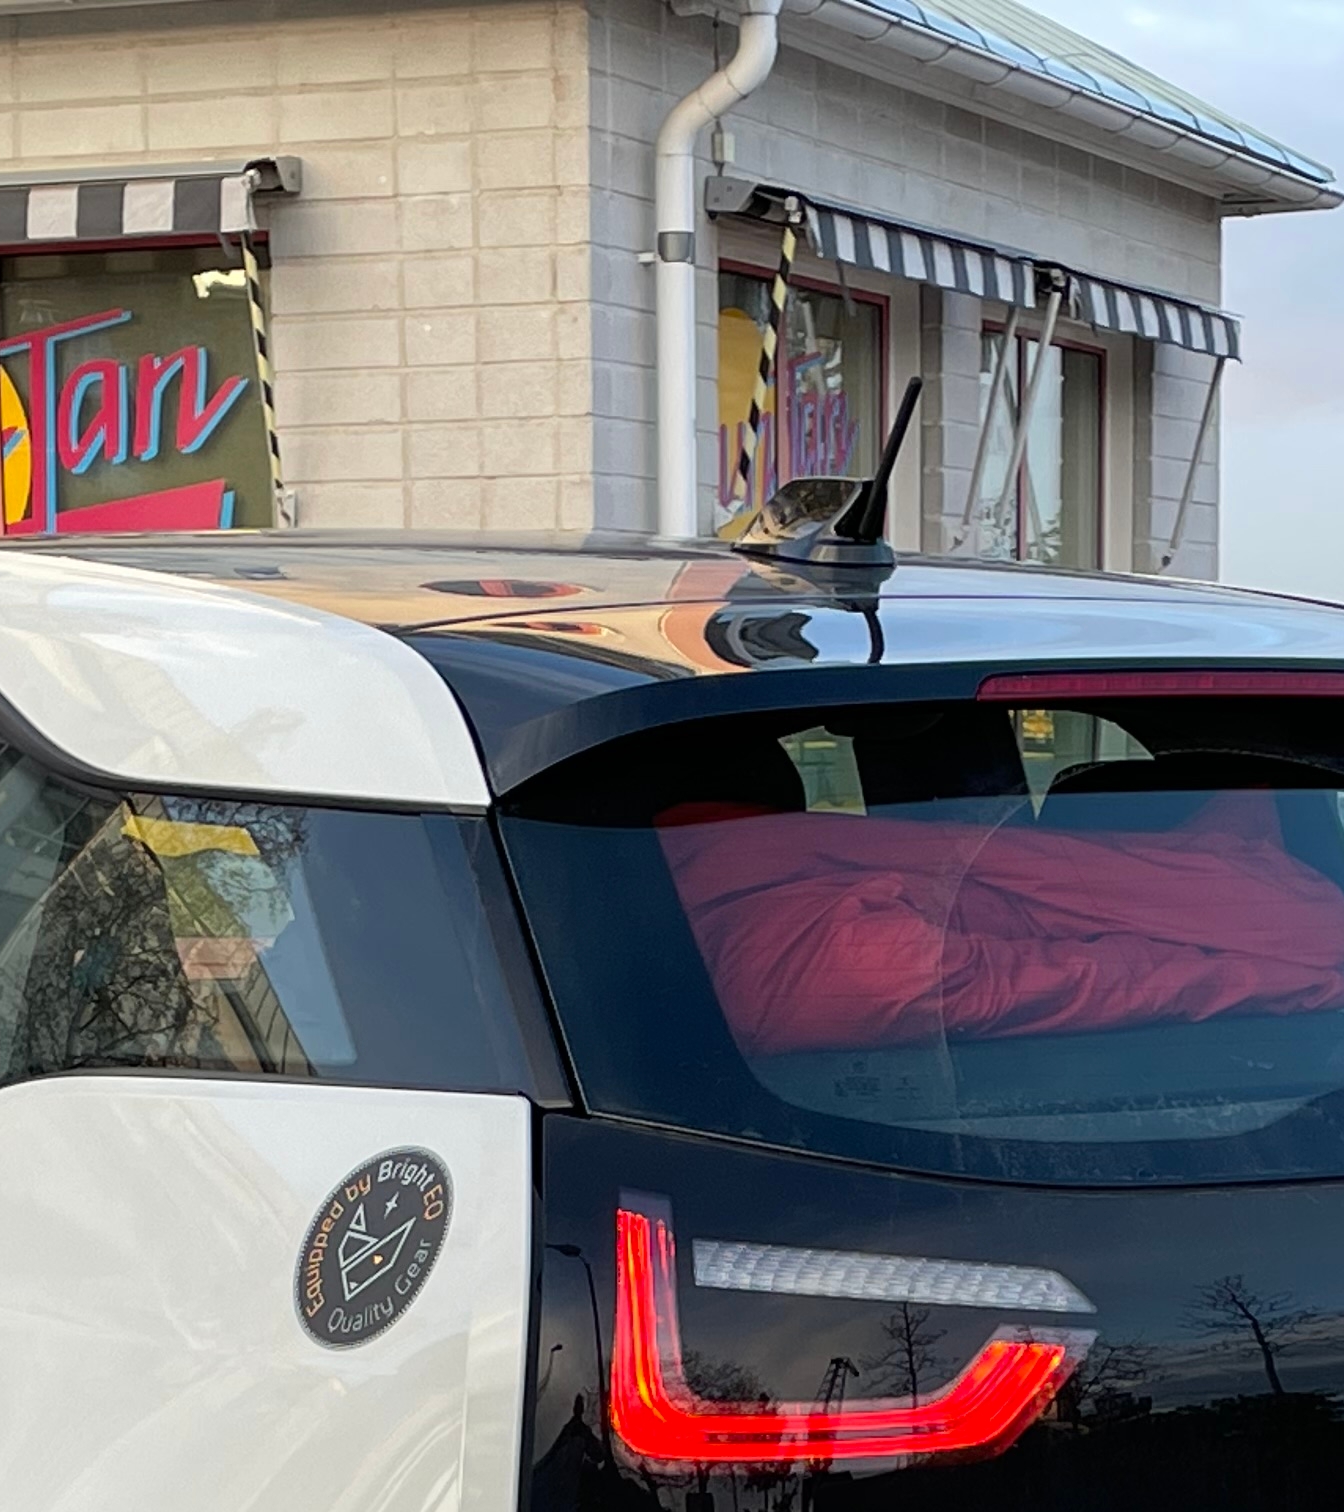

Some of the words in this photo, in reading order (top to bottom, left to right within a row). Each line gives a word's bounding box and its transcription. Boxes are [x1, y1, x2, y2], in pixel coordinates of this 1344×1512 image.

[306, 1201, 345, 1317] Equipped
[345, 1174, 372, 1203] by
[327, 1296, 395, 1334] Quality
[394, 1239, 433, 1295] Gear
